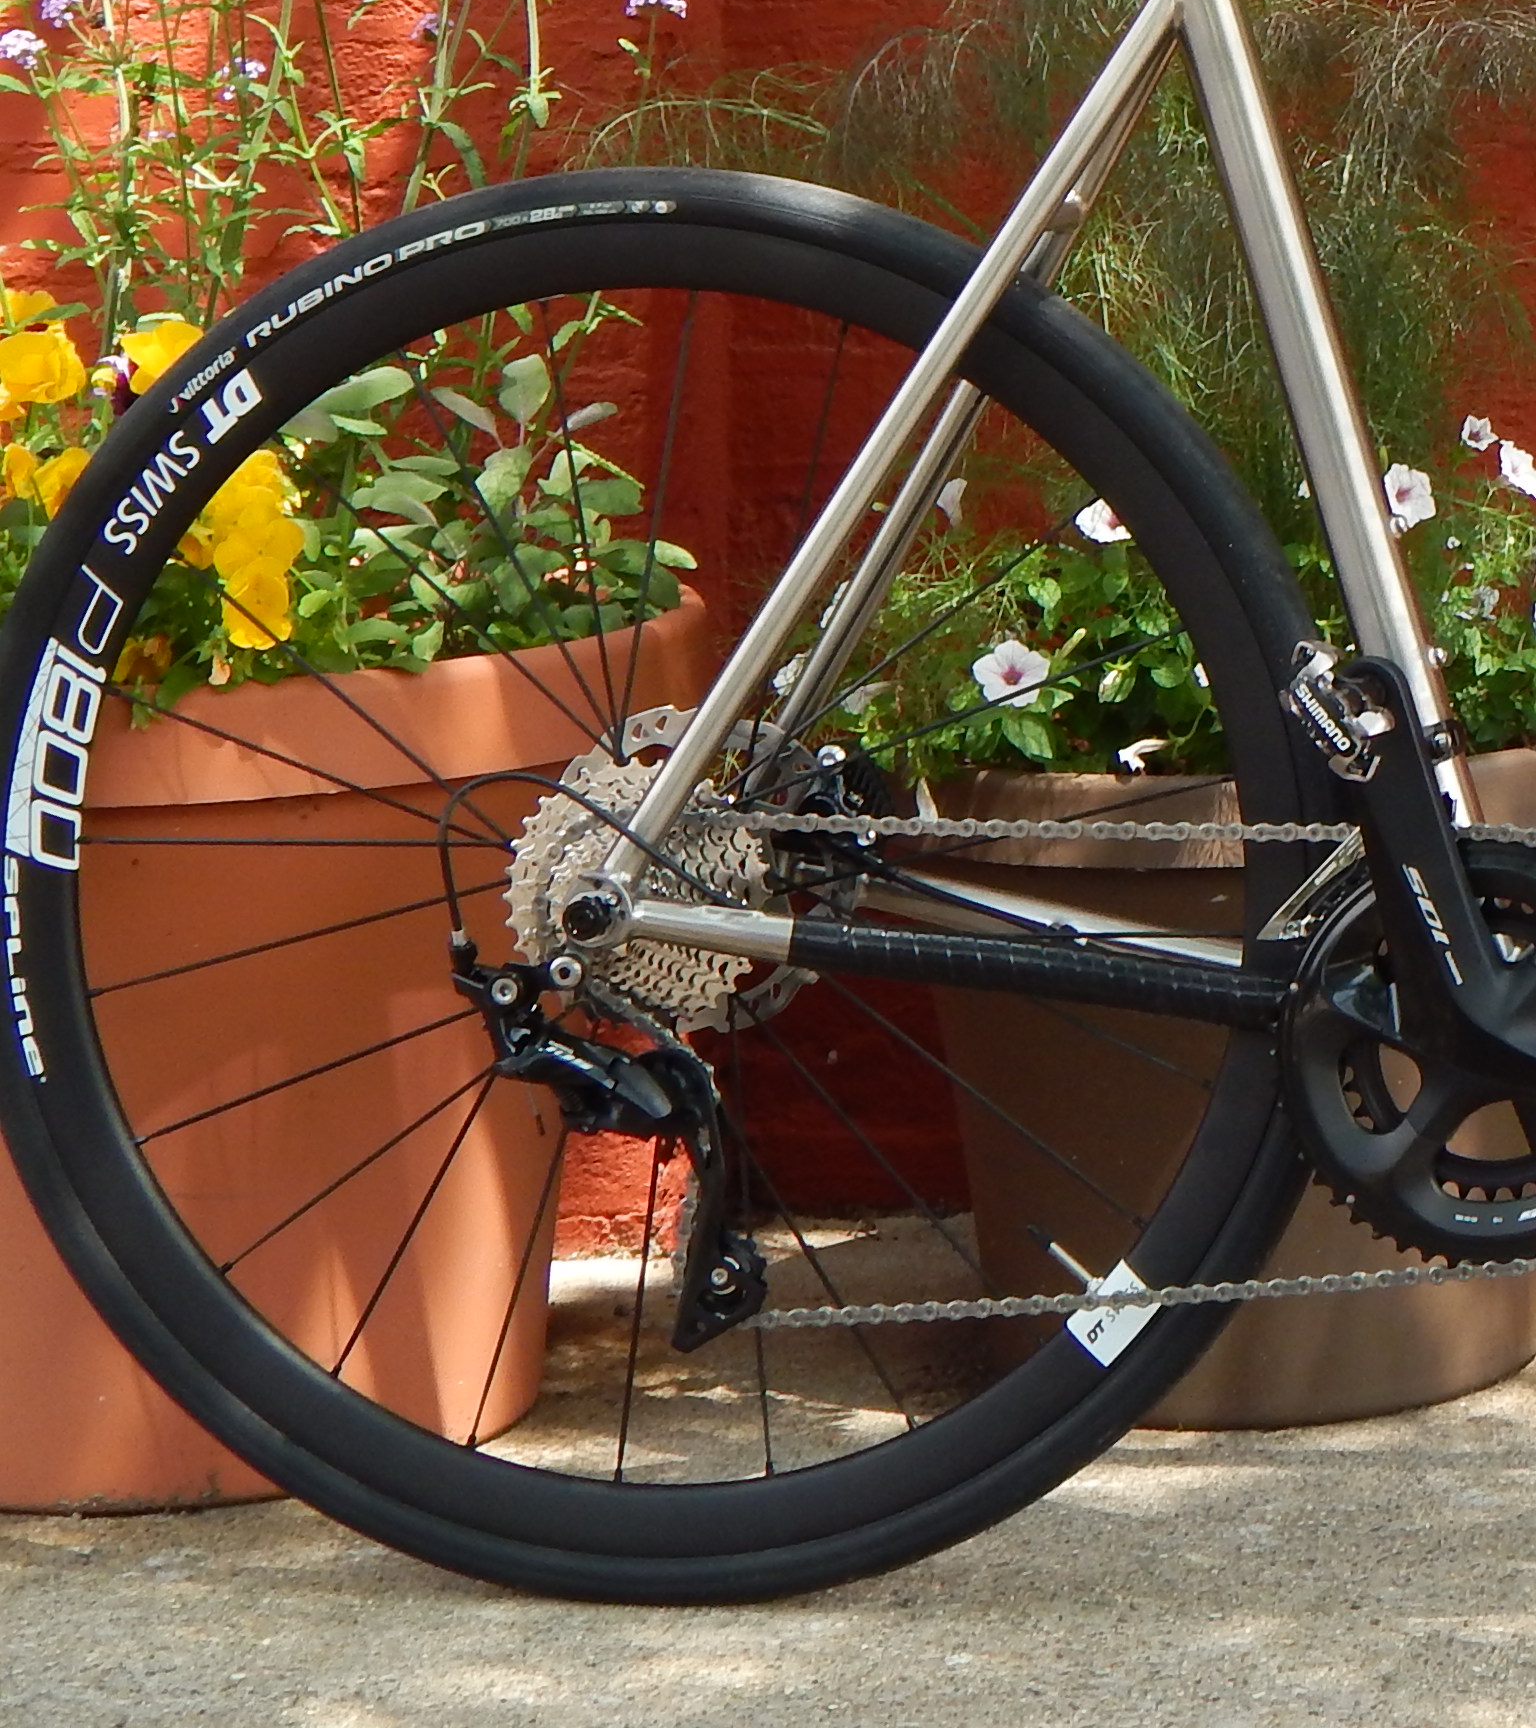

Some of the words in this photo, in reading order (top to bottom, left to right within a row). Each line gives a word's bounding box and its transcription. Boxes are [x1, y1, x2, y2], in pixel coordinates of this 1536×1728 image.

[245, 253, 394, 349] RUBINO
[398, 220, 487, 262] PRO
[200, 368, 263, 445] DT
[103, 430, 201, 555] SWISS
[30, 563, 124, 872] P1800
[1295, 683, 1351, 753] SHIMANO
[1401, 863, 1450, 946] 105
[1086, 1319, 1105, 1344] DT
